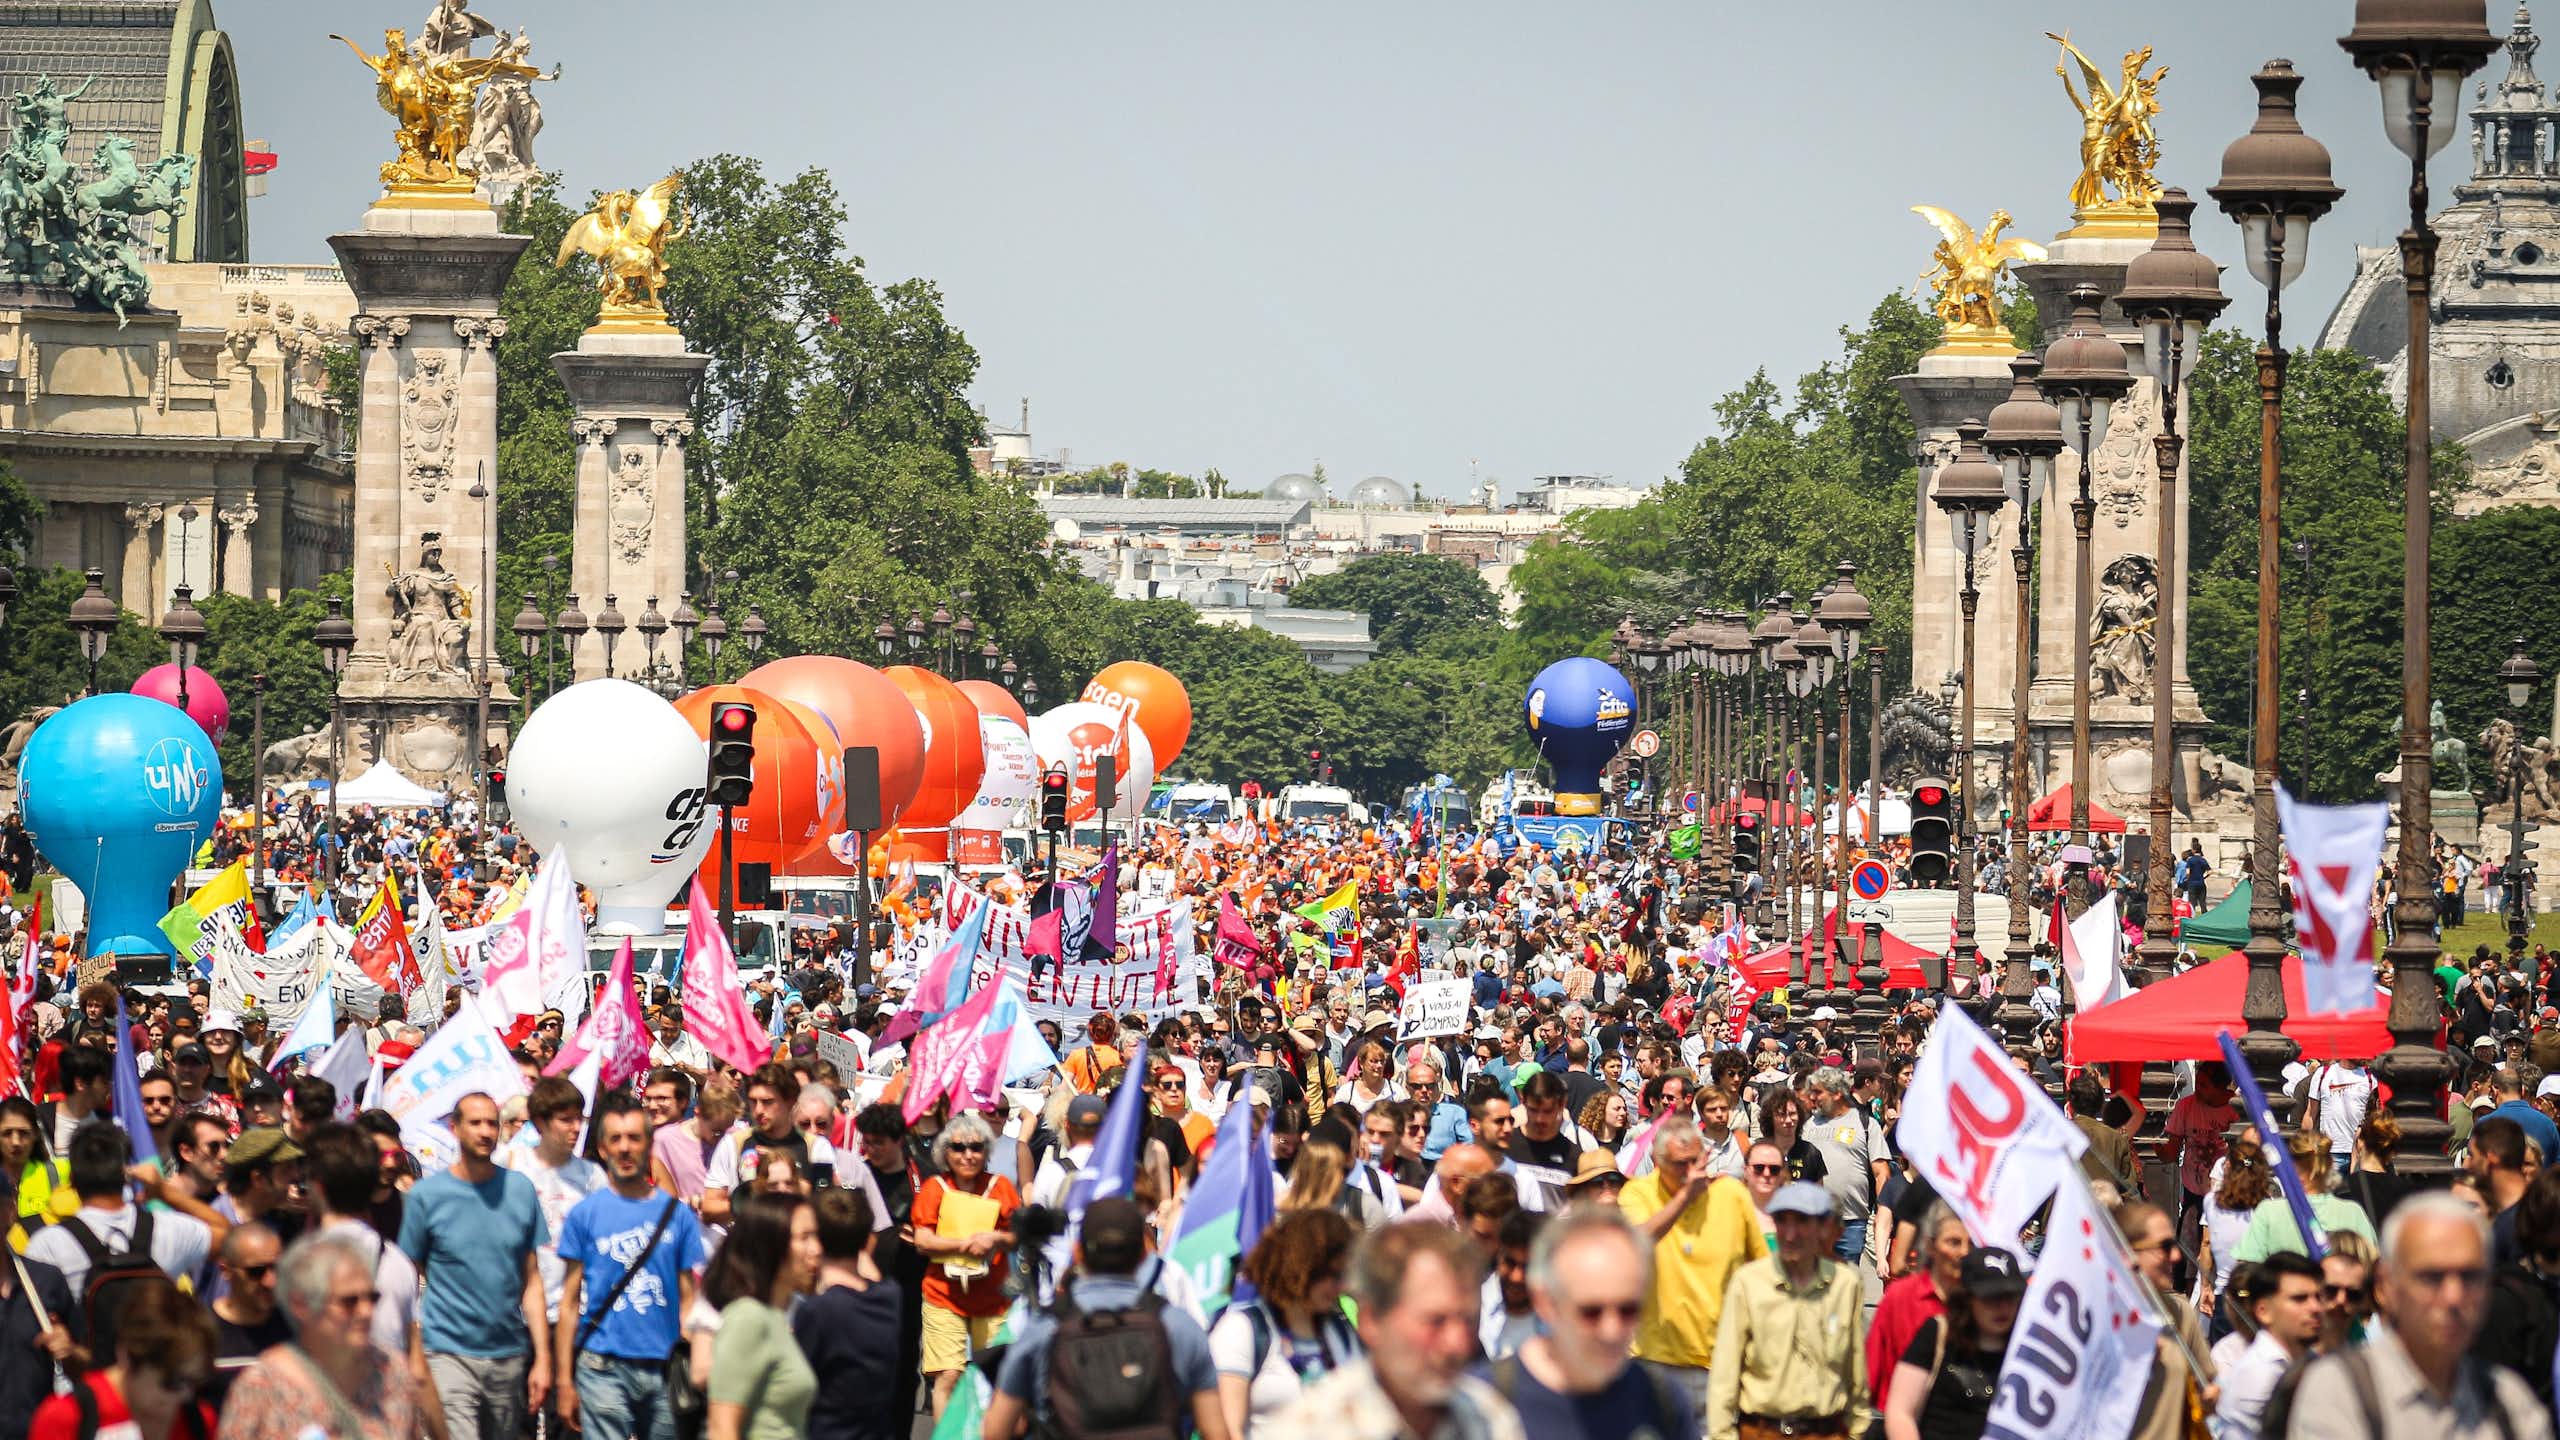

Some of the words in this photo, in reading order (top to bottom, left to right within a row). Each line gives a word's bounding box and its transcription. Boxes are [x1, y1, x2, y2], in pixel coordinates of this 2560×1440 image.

[279, 985, 306, 1003] EN
[1027, 971, 1080, 1008] EN
[1438, 987, 1453, 997] JE
[1429, 1001, 1452, 1010] VOUS
[1453, 1000, 1462, 1008] AI
[1423, 1015, 1460, 1031] COMPRIS
